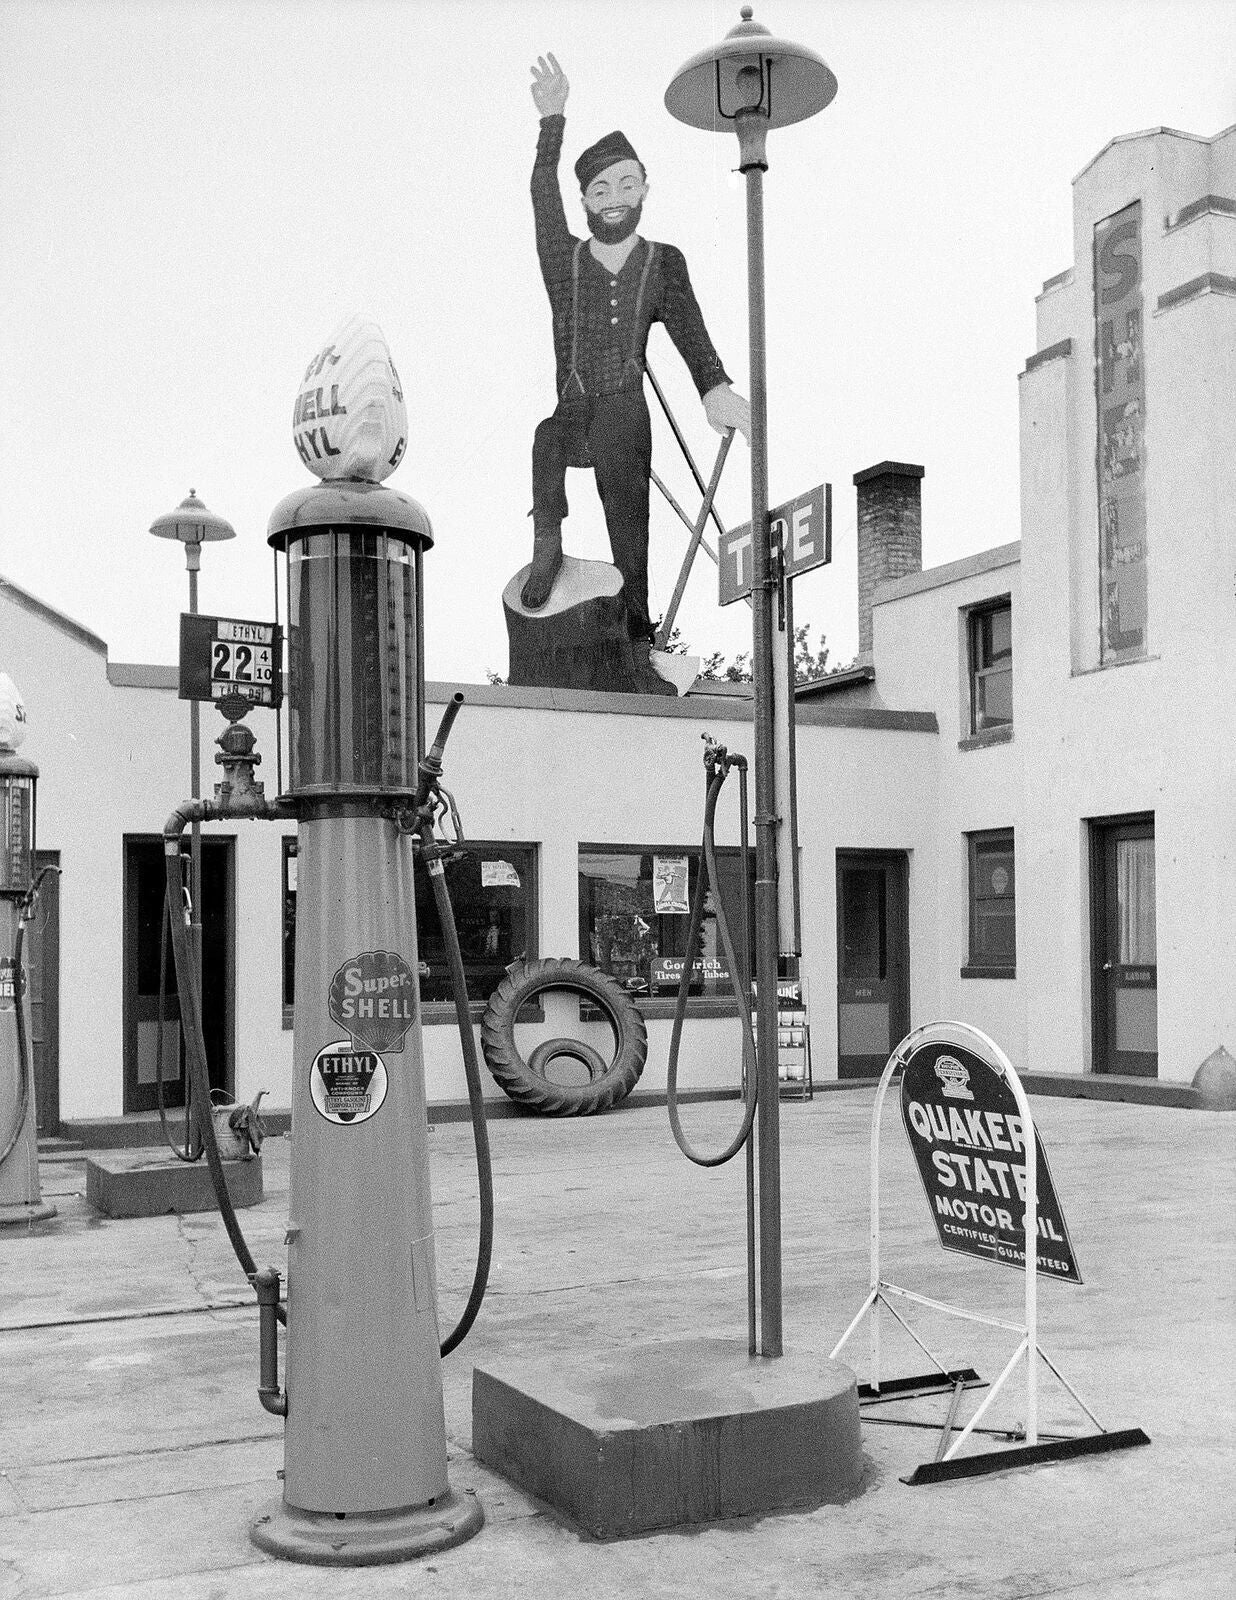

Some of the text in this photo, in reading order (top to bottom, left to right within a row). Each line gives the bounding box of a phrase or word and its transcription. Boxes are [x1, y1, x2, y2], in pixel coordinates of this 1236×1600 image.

[233, 625, 262, 640] ETHYL
[213, 643, 269, 682] 22 4
[256, 668, 272, 681] 10
[345, 968, 411, 996] Super
[655, 970, 729, 980] Tires Tubes
[341, 998, 411, 1018] SHELL
[323, 1056, 374, 1073] ETHYL
[909, 1101, 1028, 1153] QUAKER
[932, 1150, 1039, 1204] STATE
[935, 1195, 1015, 1231] MOTOR
[944, 1223, 996, 1244] CERTIFIED
[998, 1246, 1070, 1272] GUARNTEED
